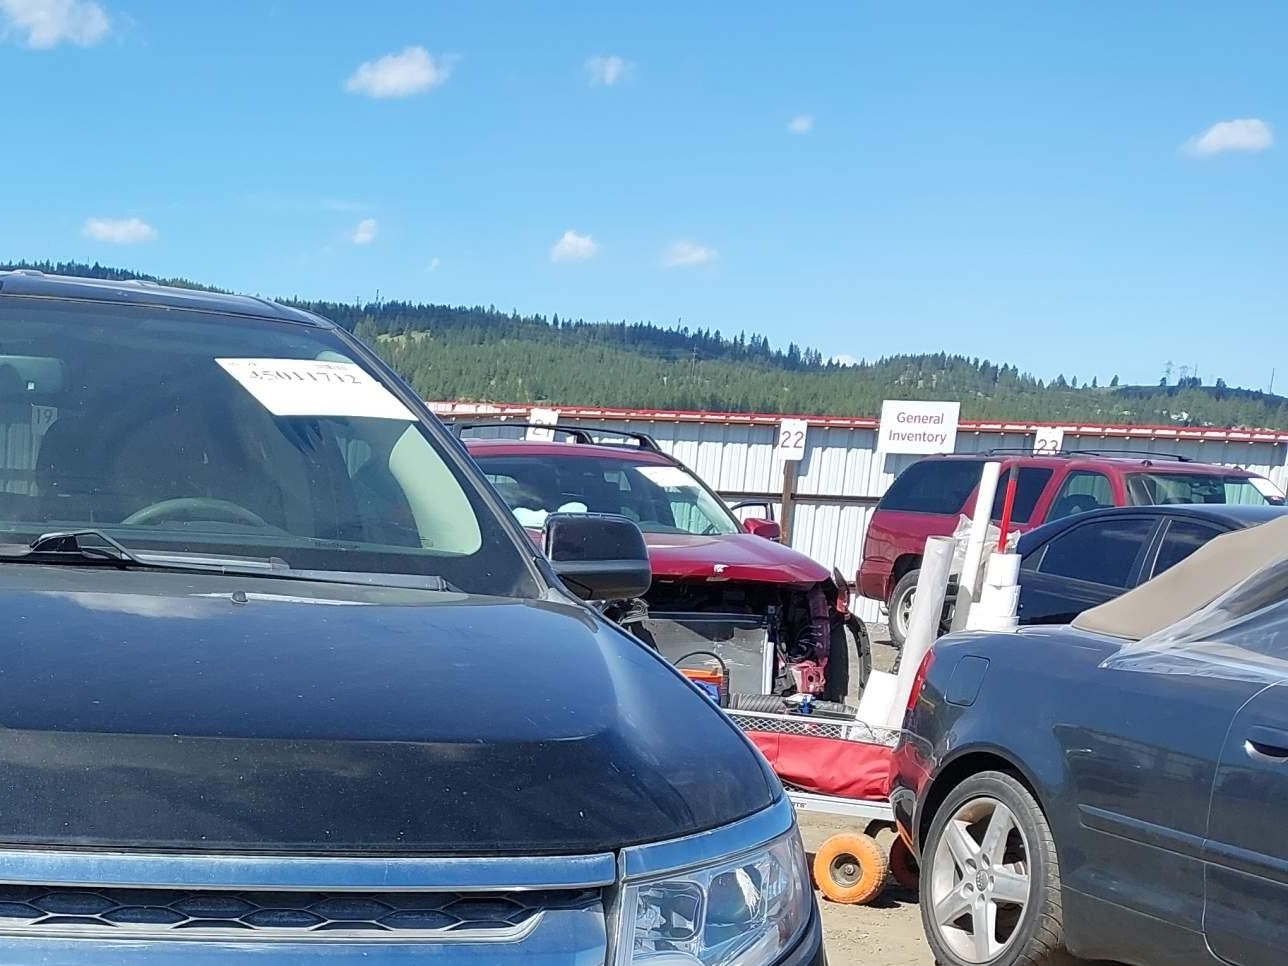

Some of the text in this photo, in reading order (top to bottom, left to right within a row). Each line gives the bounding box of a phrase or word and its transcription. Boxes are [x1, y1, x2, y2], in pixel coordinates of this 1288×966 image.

[37, 408, 52, 425] 19
[896, 411, 944, 425] General
[781, 430, 804, 448] 22
[888, 429, 948, 445] Inventory
